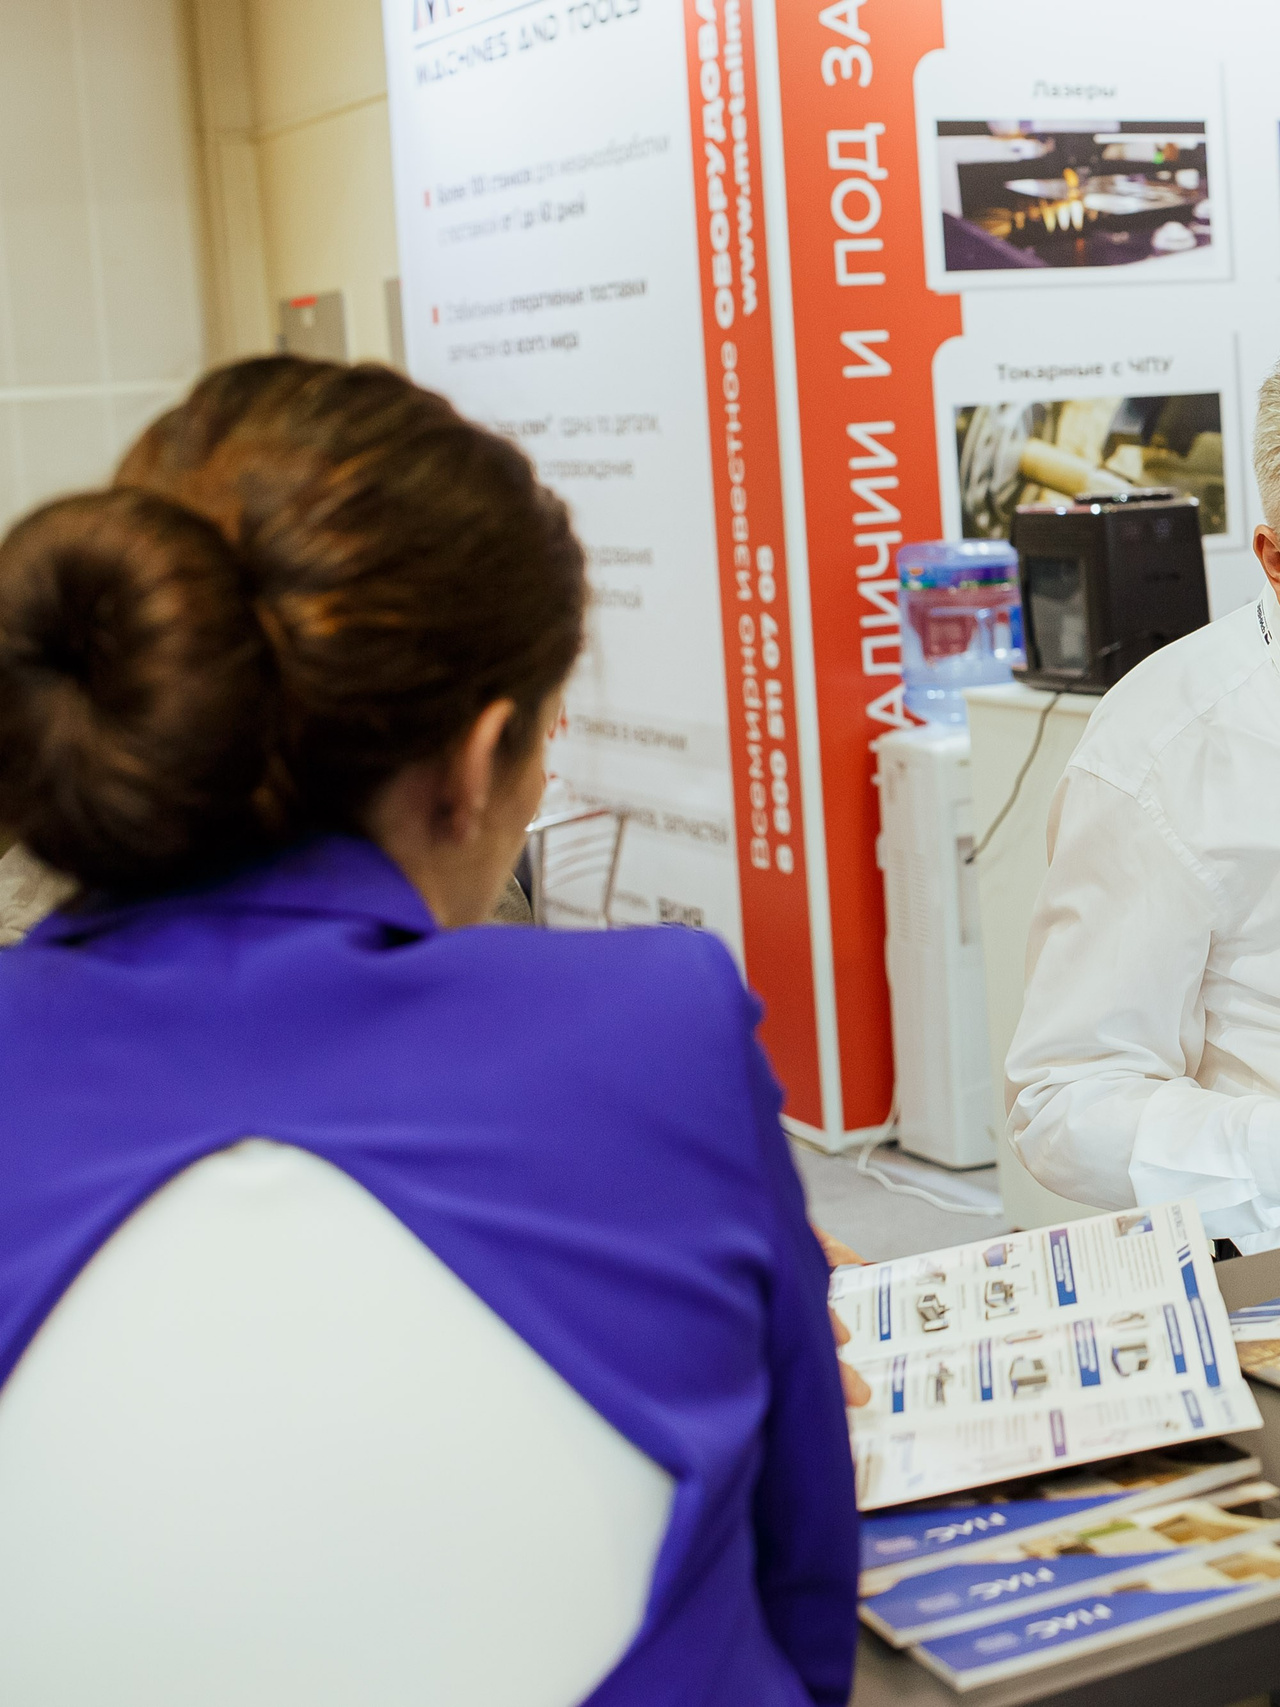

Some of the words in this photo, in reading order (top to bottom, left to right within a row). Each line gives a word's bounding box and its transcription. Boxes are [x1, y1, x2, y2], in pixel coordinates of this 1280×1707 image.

[519, 14, 558, 51] AND
[1033, 79, 1118, 102] Лазеры
[825, 122, 889, 288] ПОД
[840, 329, 892, 379] И
[996, 360, 1104, 384] Токарные
[1112, 360, 1122, 377] с
[1128, 356, 1174, 378] ЧПУ
[720, 340, 753, 601] известное
[755, 544, 777, 604] 08
[759, 611, 780, 670] 07
[738, 612, 771, 871] Всемирно
[768, 747, 792, 836] 800
[775, 843, 794, 876] 8
